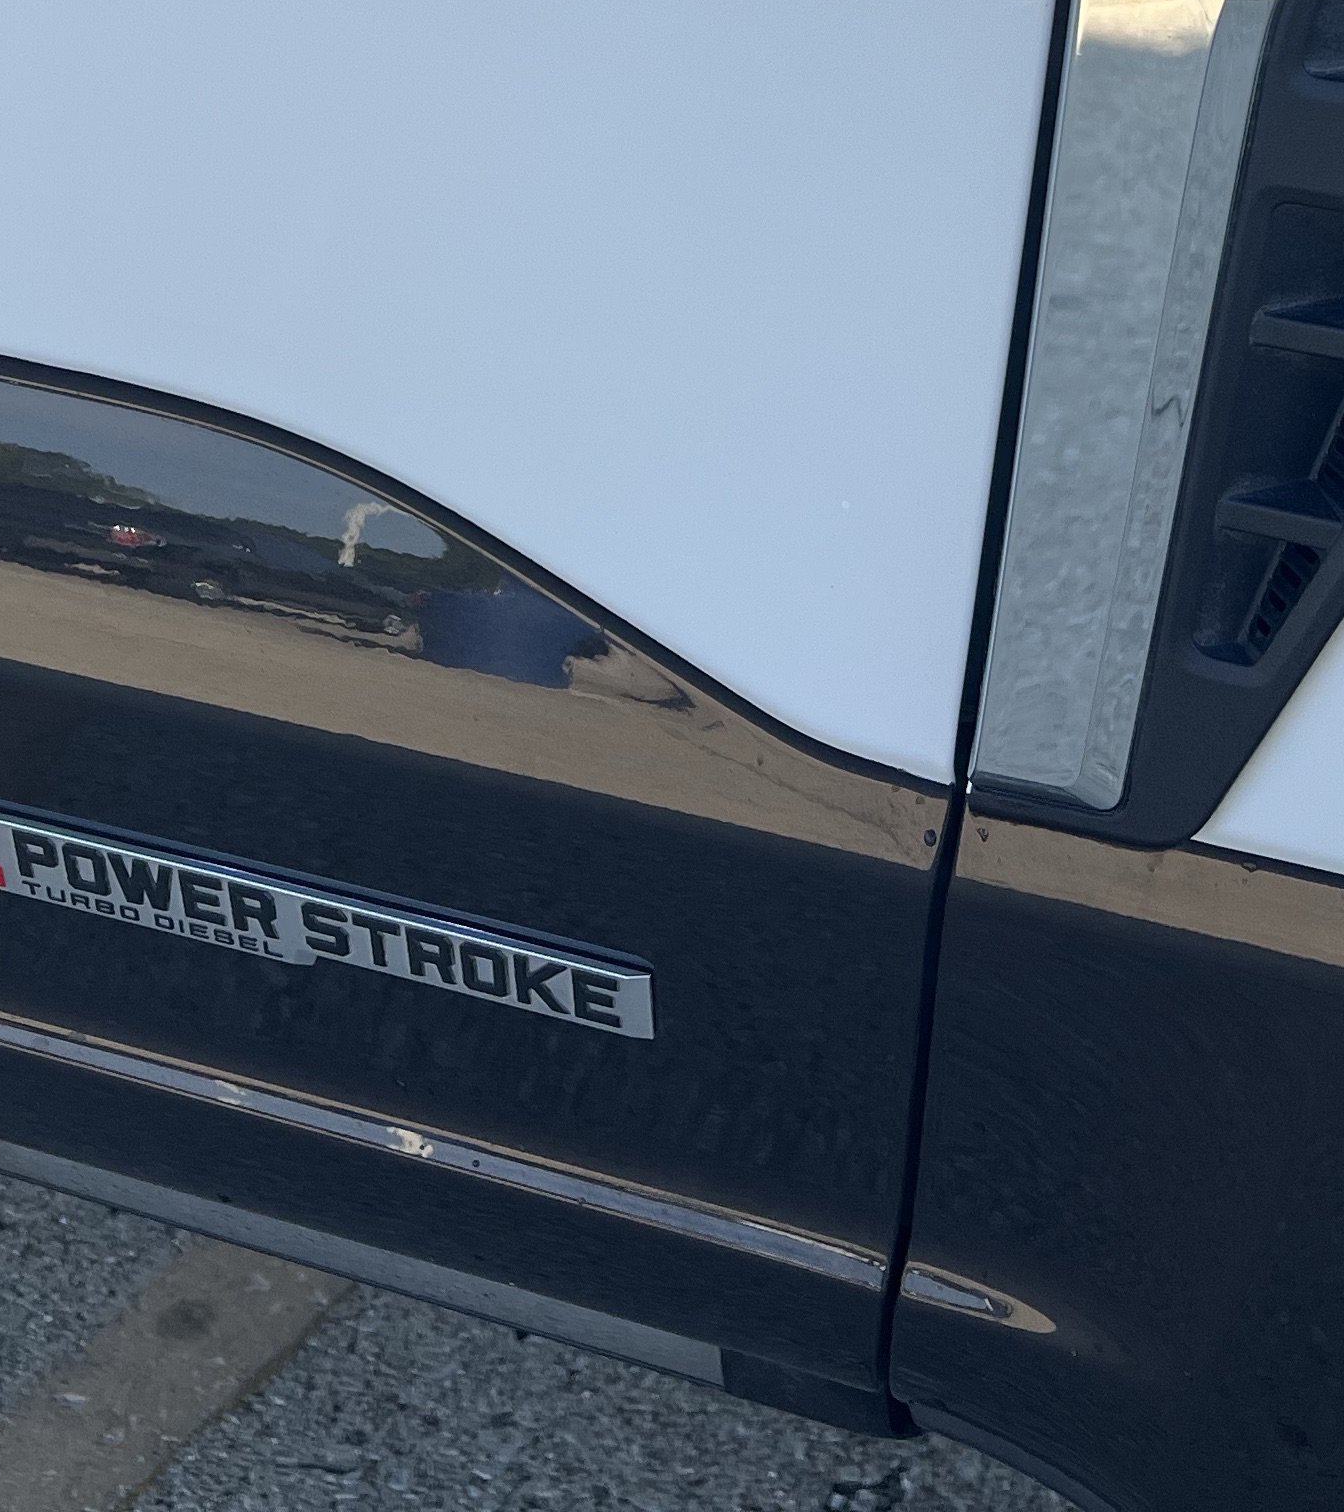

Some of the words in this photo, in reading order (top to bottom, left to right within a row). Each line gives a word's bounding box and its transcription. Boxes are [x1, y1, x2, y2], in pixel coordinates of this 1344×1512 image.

[10, 828, 280, 939] POWER
[301, 901, 623, 1029] STROKE
[22, 879, 141, 922] TURBO
[154, 912, 284, 959] DIESEL
